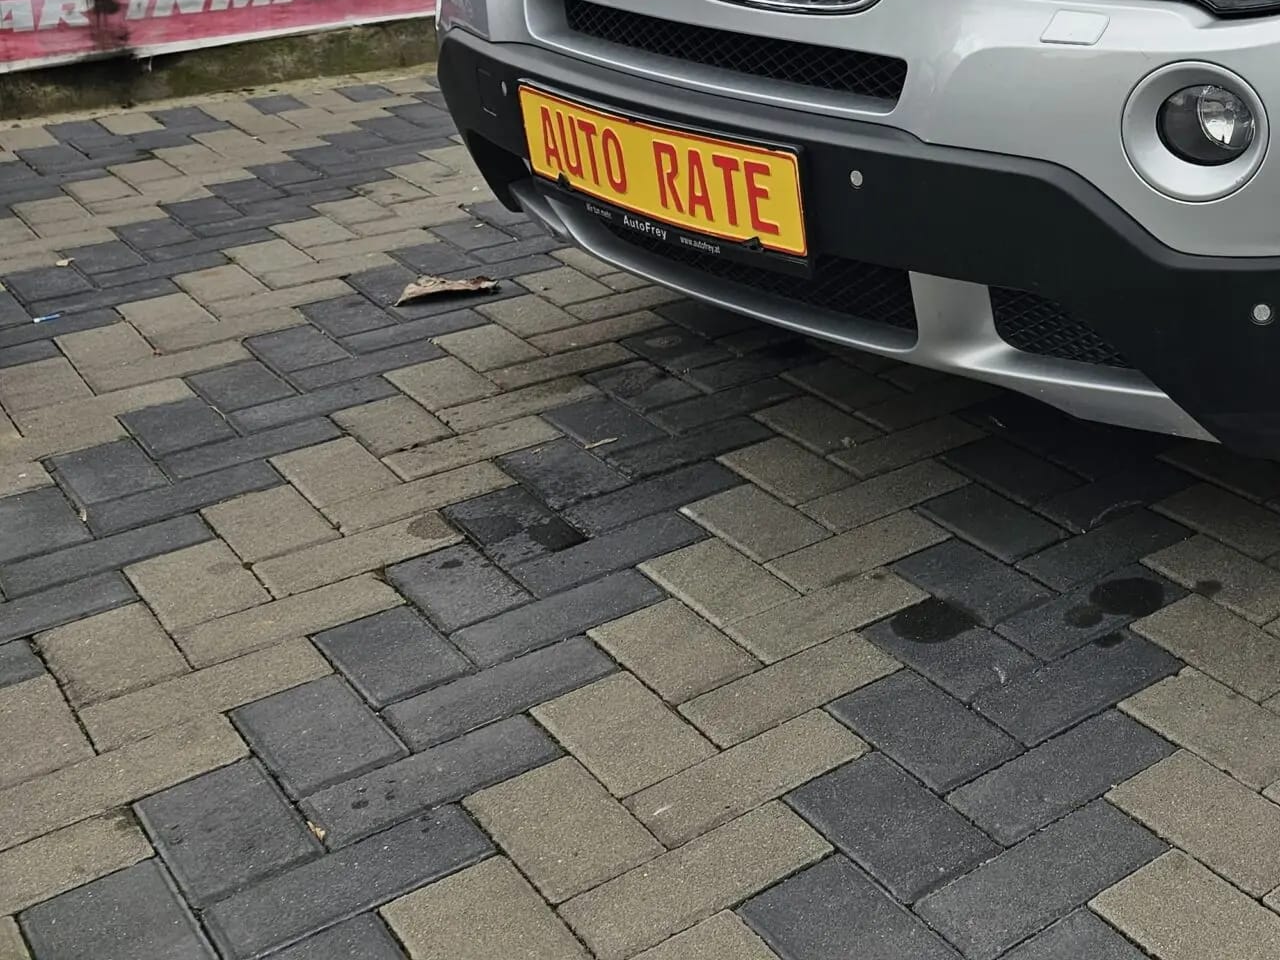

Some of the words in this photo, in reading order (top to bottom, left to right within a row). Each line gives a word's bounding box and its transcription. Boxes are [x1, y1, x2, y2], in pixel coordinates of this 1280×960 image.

[540, 105, 628, 194] AUTO
[652, 140, 780, 236] RATE
[623, 215, 668, 240] AutoFrey
